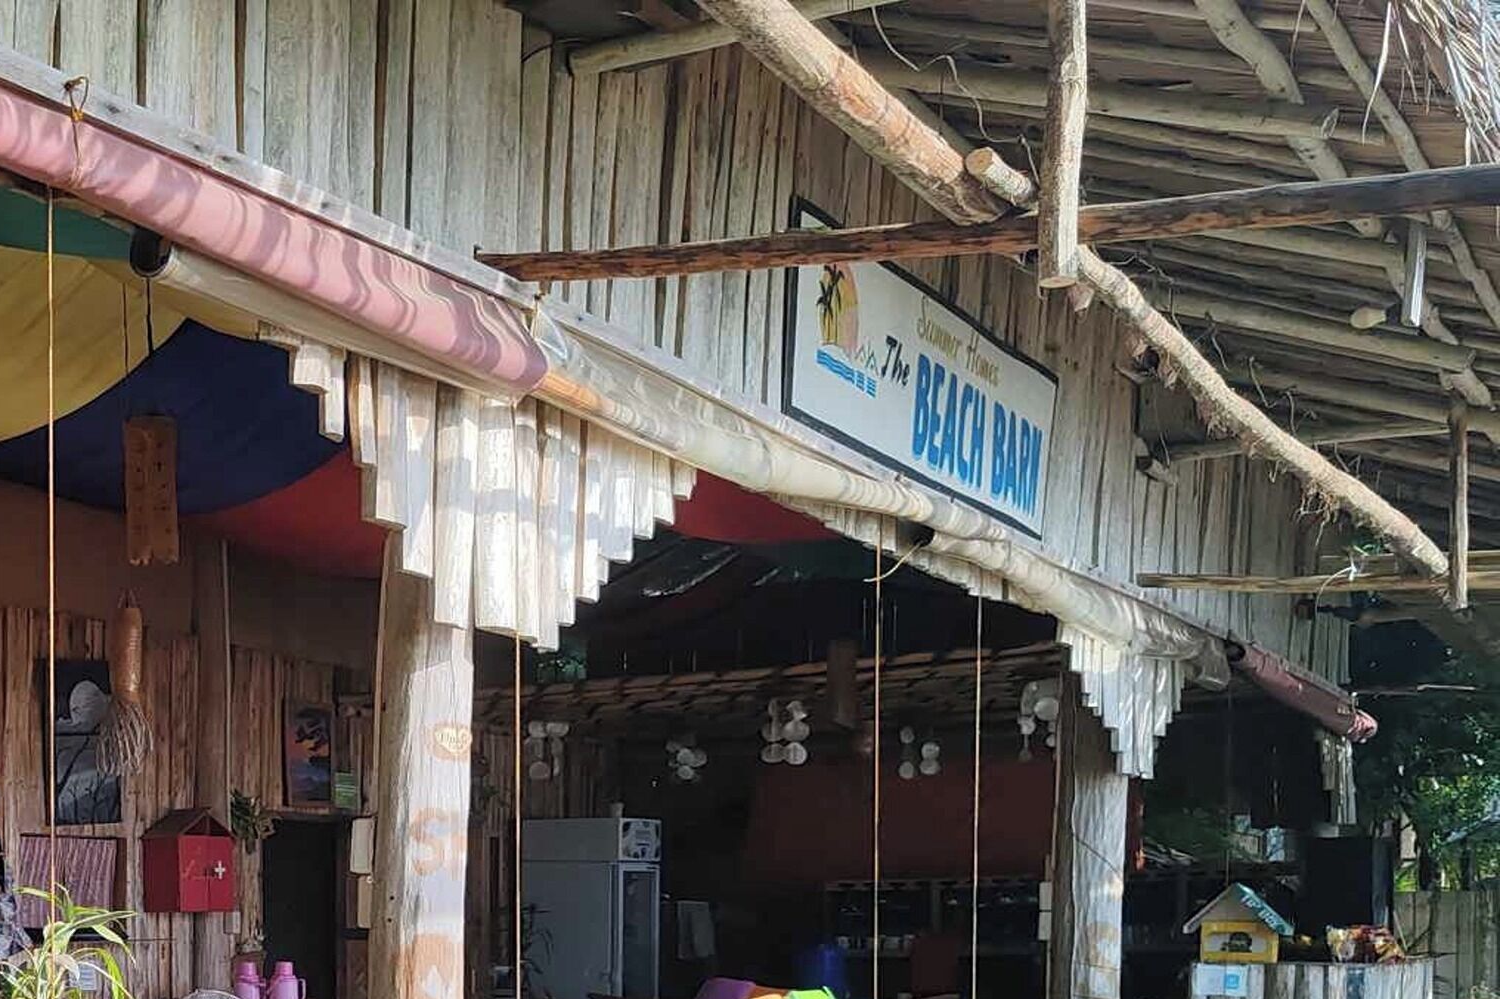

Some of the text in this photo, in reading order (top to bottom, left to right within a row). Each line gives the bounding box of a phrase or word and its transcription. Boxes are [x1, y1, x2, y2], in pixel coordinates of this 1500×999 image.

[881, 334, 911, 387] The
[913, 353, 1043, 518] BEACH BARN
